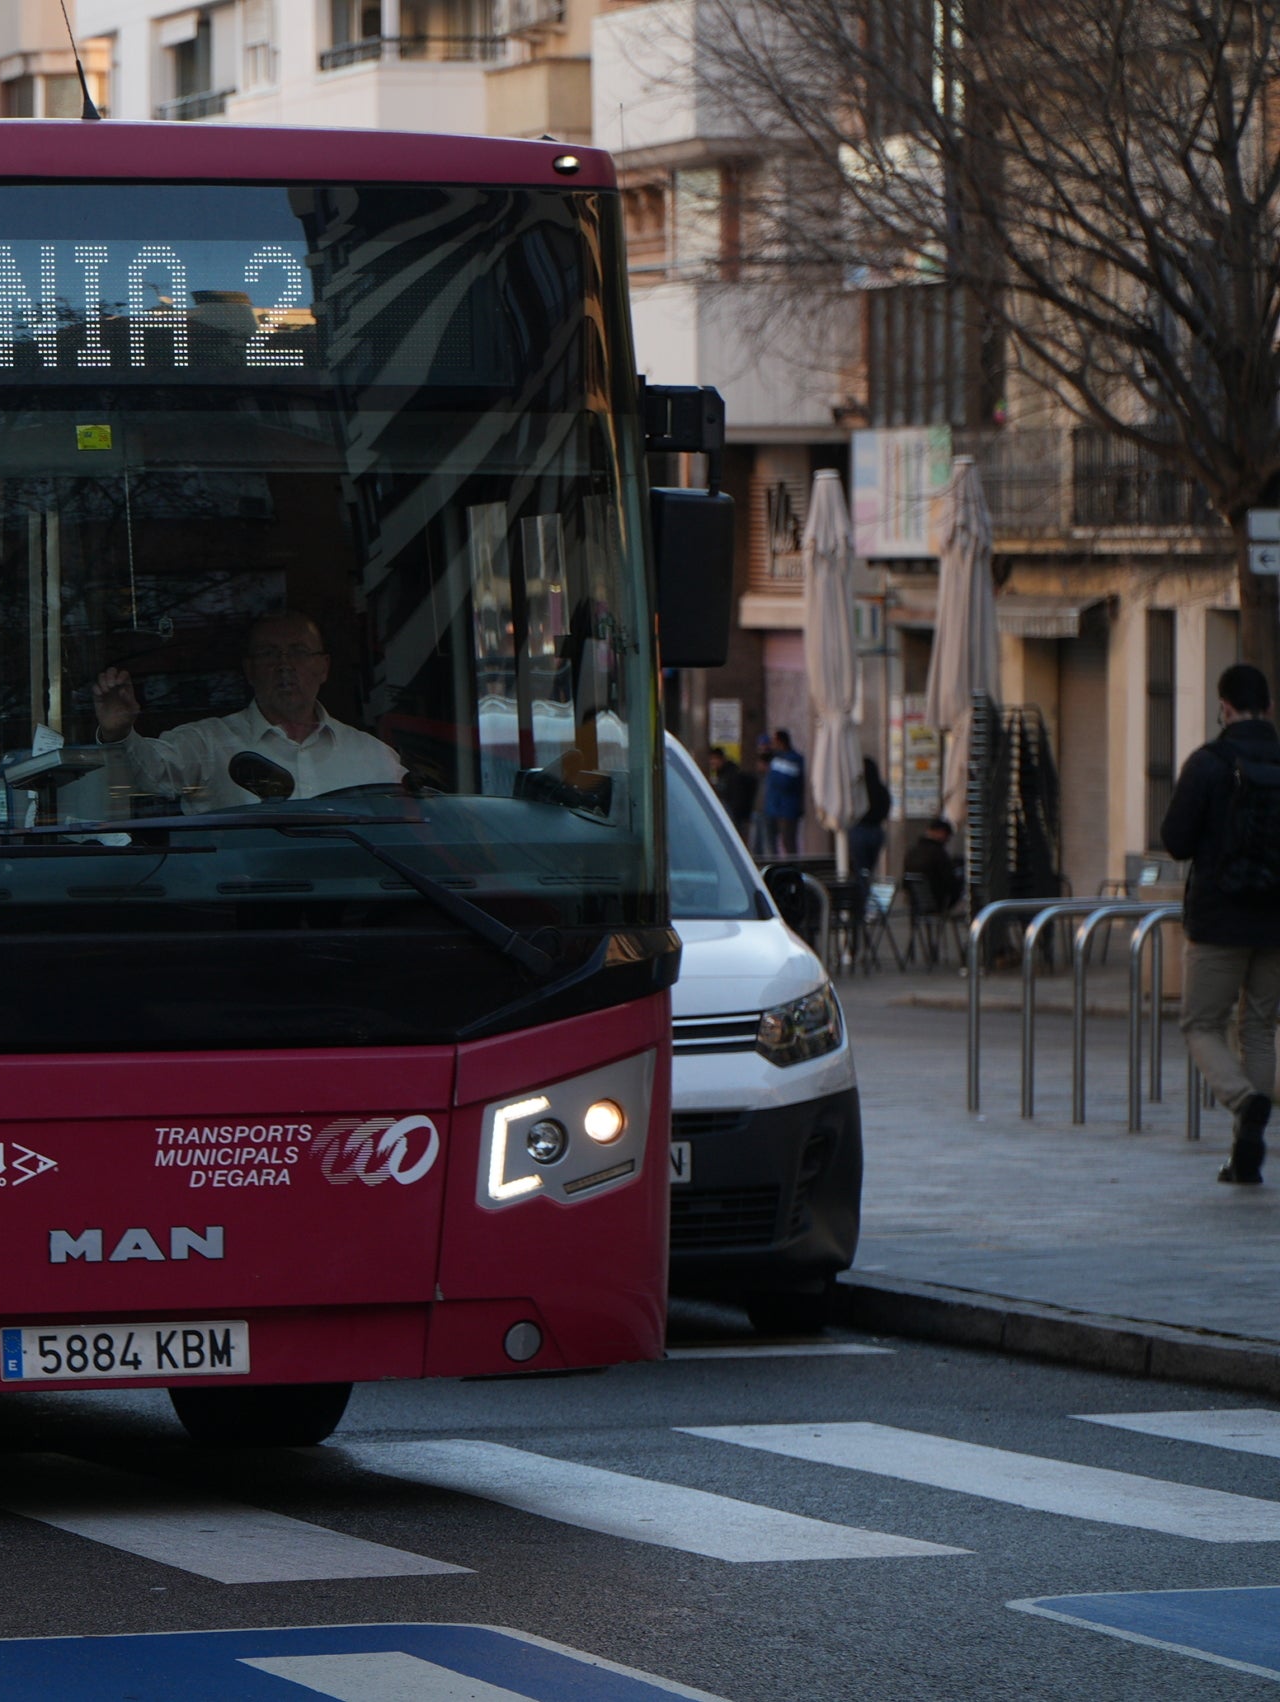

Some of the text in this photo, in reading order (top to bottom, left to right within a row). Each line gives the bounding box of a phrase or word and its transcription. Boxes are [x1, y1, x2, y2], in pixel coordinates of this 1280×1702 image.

[243, 245, 305, 368] 2
[155, 1123, 313, 1145] TRANSPORTS
[154, 1146, 300, 1167] MUNICIPALS
[189, 1168, 292, 1188] D'EGARA
[48, 1225, 225, 1264] MAN
[8, 1328, 233, 1374] E 5884 KBM
